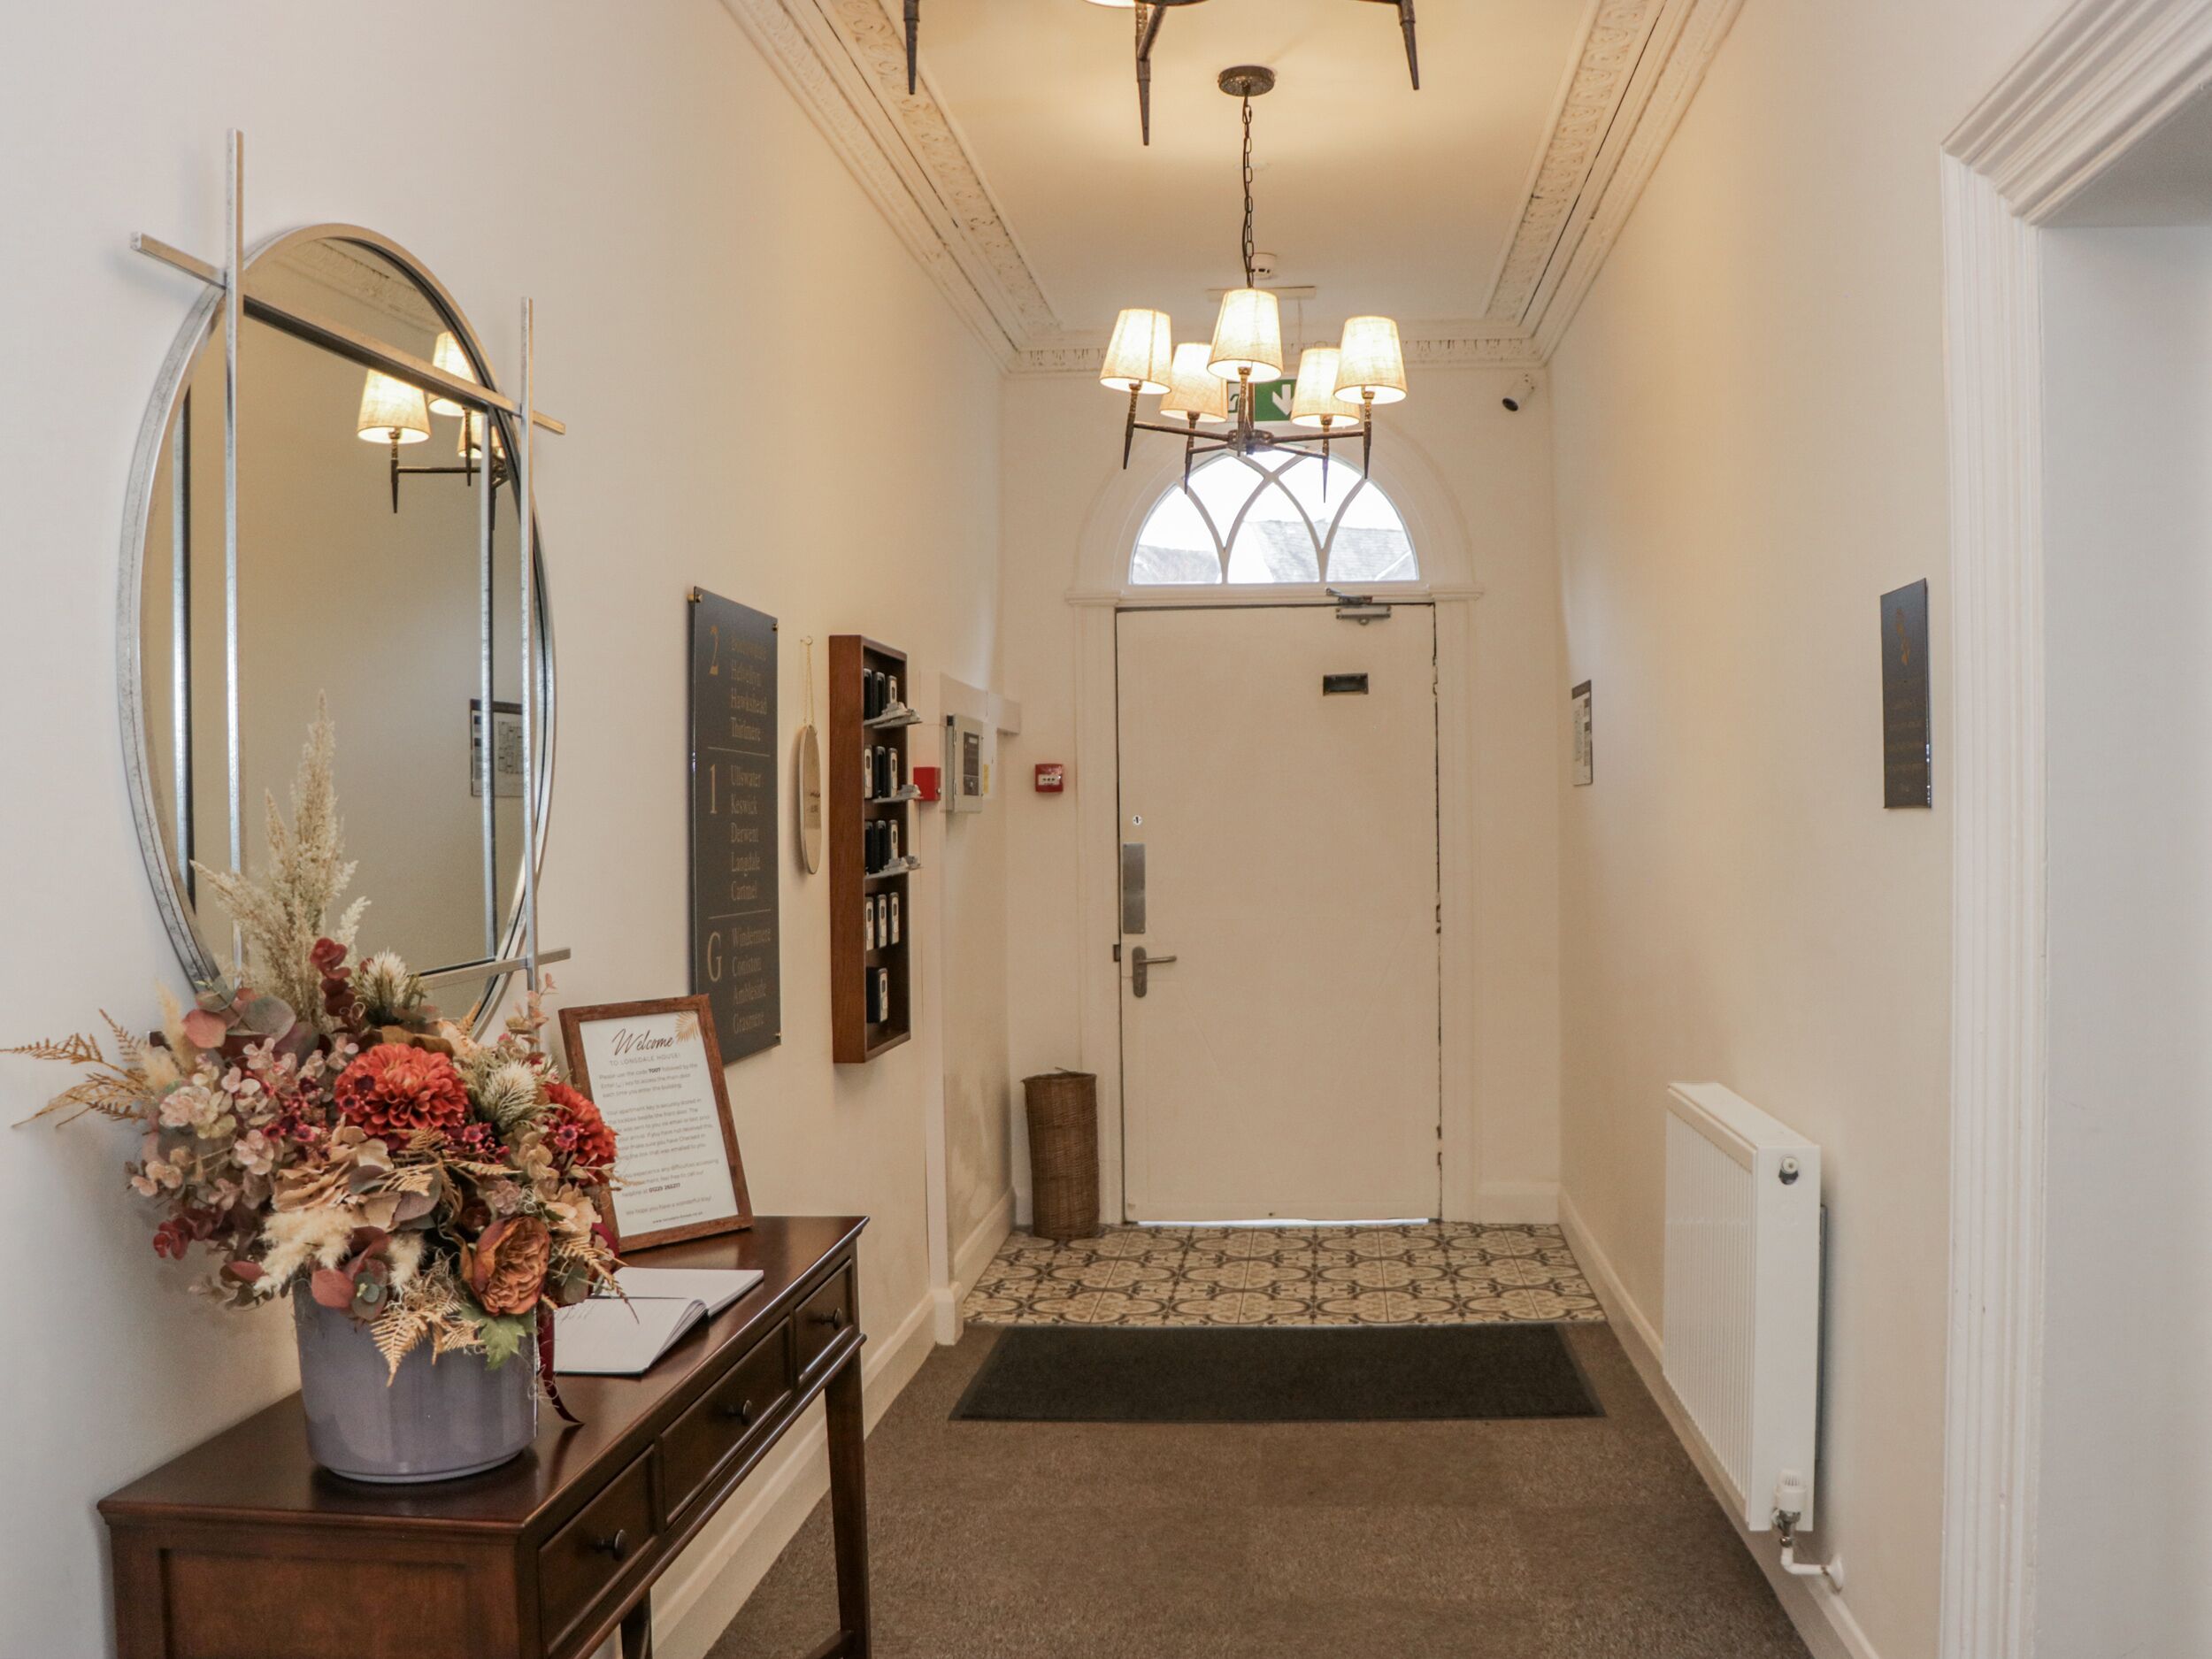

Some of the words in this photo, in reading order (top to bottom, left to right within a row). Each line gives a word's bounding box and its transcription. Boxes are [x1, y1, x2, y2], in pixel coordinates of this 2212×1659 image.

[709, 625, 718, 676] 2
[730, 687, 767, 716] Hawkshead
[730, 764, 762, 787] Ullswater
[710, 764, 718, 814] 1
[731, 793, 758, 815] Keswick
[731, 822, 759, 842] Derwent
[731, 851, 761, 877] Langdale
[731, 879, 758, 901] Cartmel
[732, 927, 771, 948] Windermere
[708, 932, 722, 982] G
[732, 956, 762, 977] Coniston
[733, 1012, 764, 1034] Grasmere
[611, 1027, 673, 1056] Welcome
[621, 1055, 655, 1065] LONSDALE
